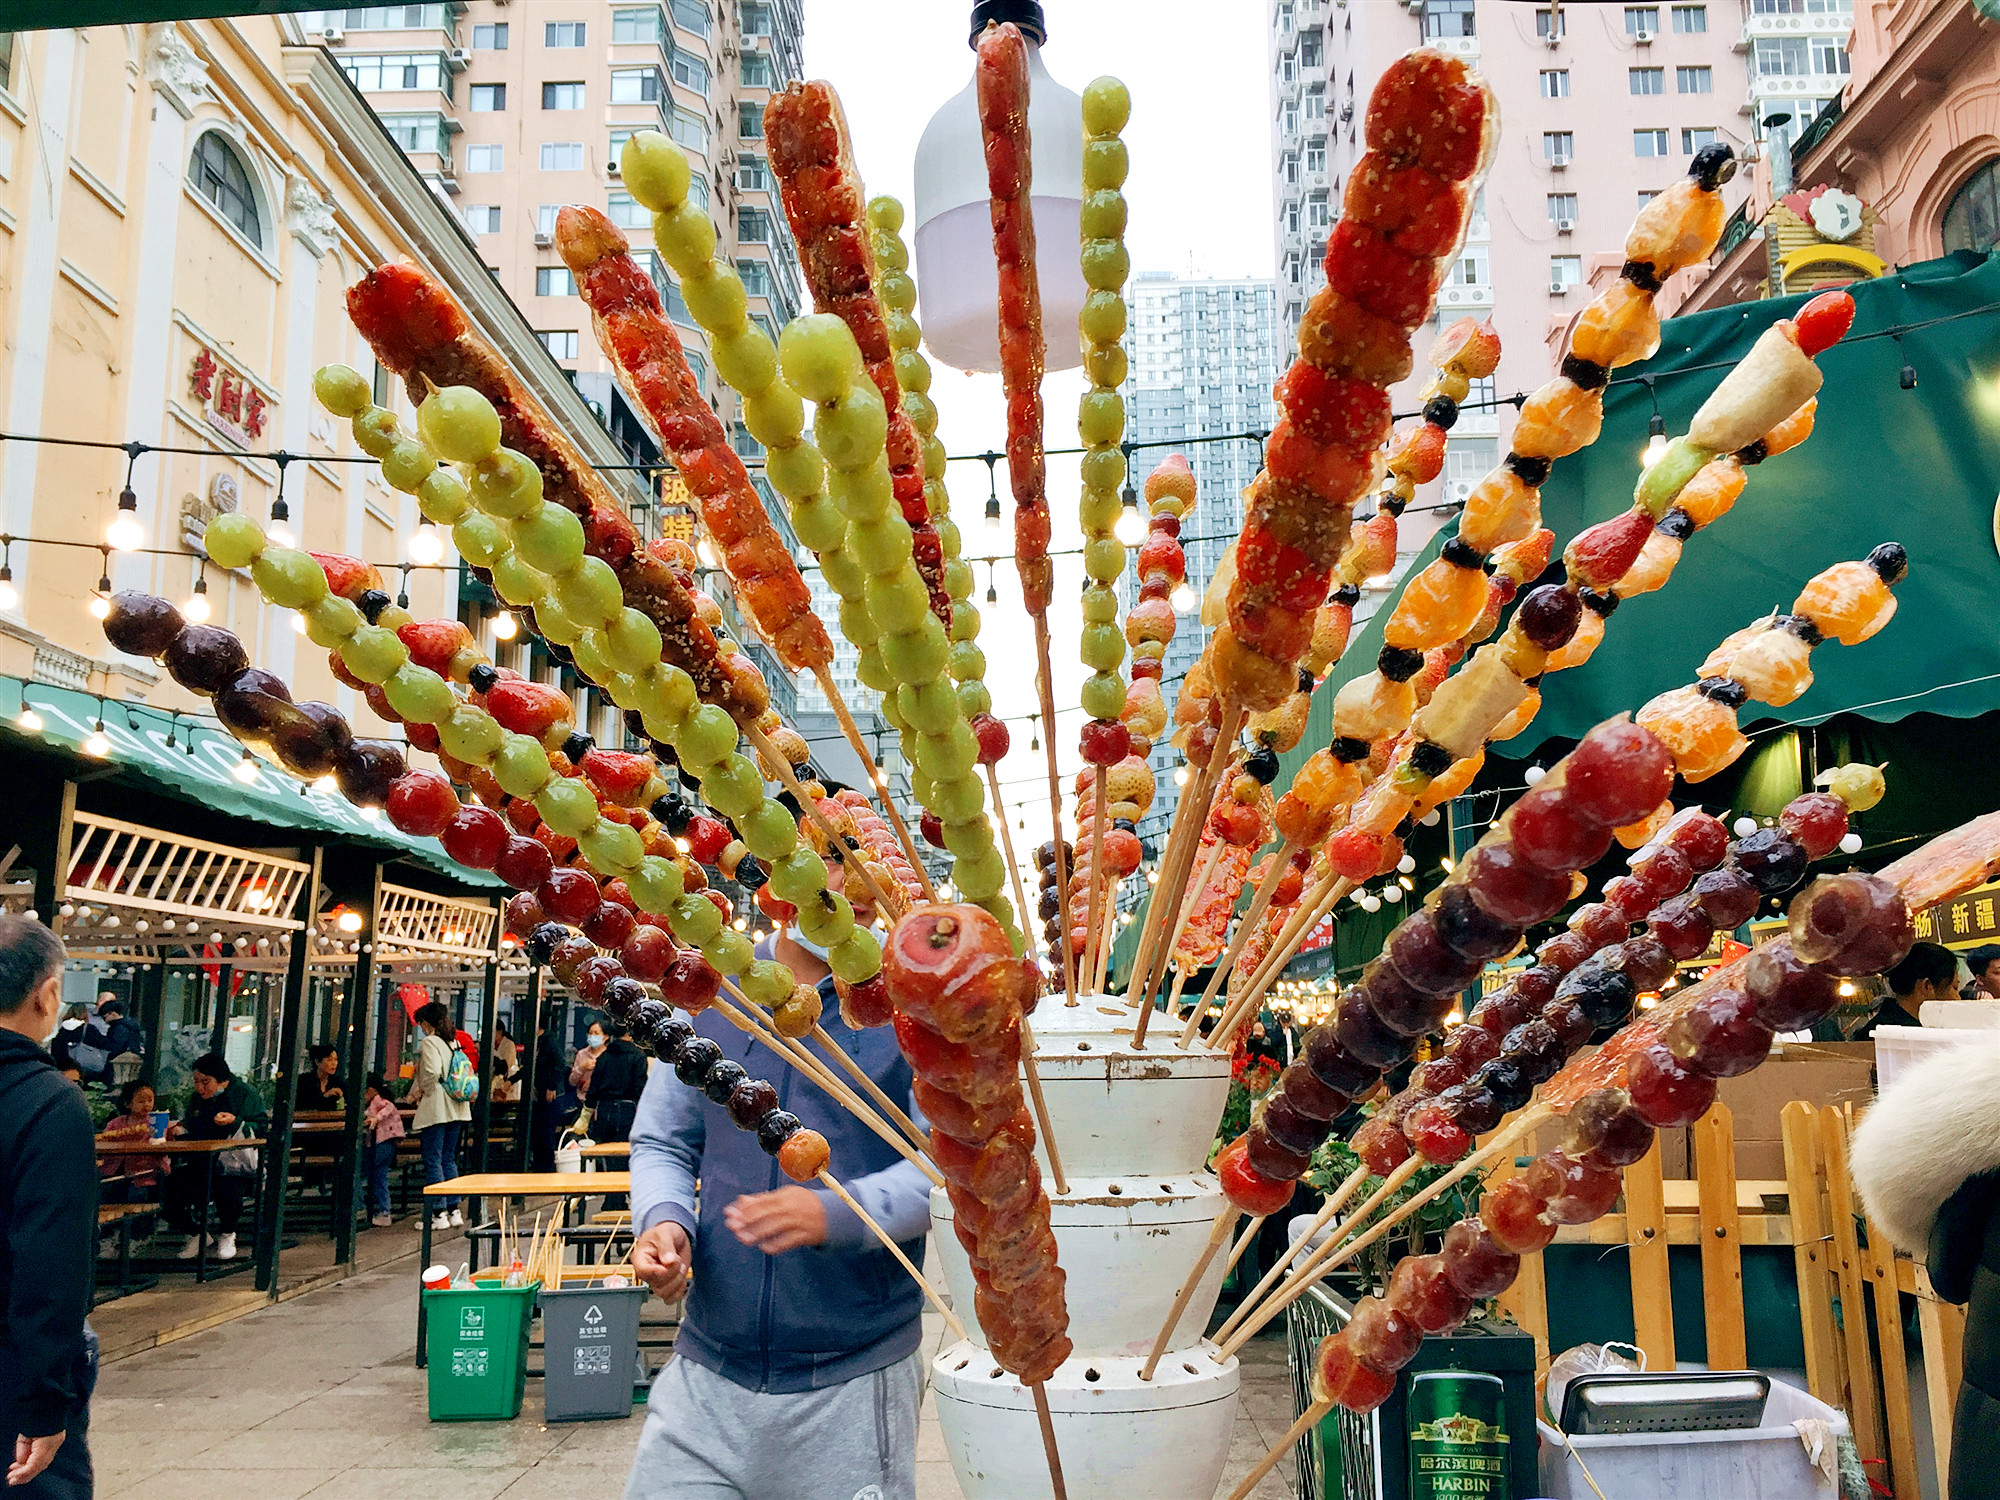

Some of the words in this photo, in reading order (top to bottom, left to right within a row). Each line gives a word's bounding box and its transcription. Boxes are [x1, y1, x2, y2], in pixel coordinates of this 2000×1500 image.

[1951, 898, 1996, 934] 新疆
[1420, 1457, 1501, 1471] 哈尔滨啤酒
[1432, 1476, 1490, 1492] HARBIN
